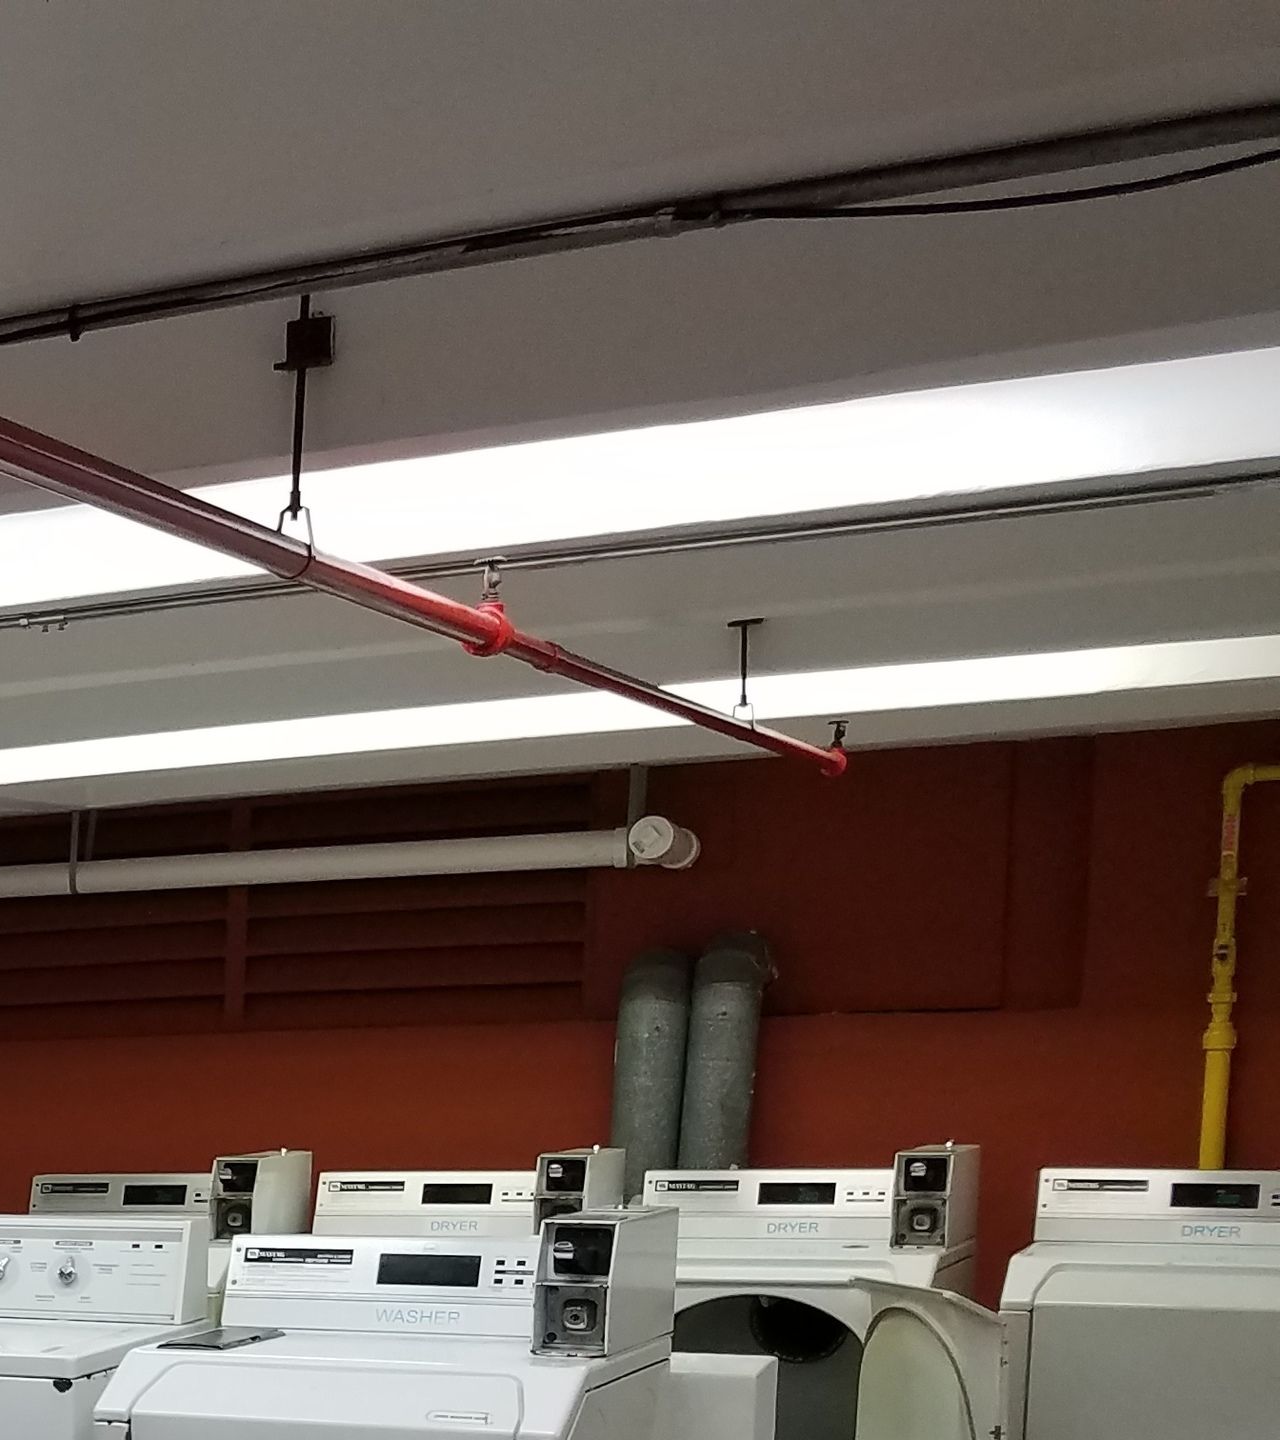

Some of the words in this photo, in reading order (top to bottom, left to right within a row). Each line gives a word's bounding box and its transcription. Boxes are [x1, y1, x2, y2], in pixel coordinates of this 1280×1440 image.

[431, 1221, 478, 1231] DRYER
[767, 1222, 819, 1232] DRYER
[1182, 1225, 1240, 1238] DRYER
[376, 1309, 460, 1324] WASHER
